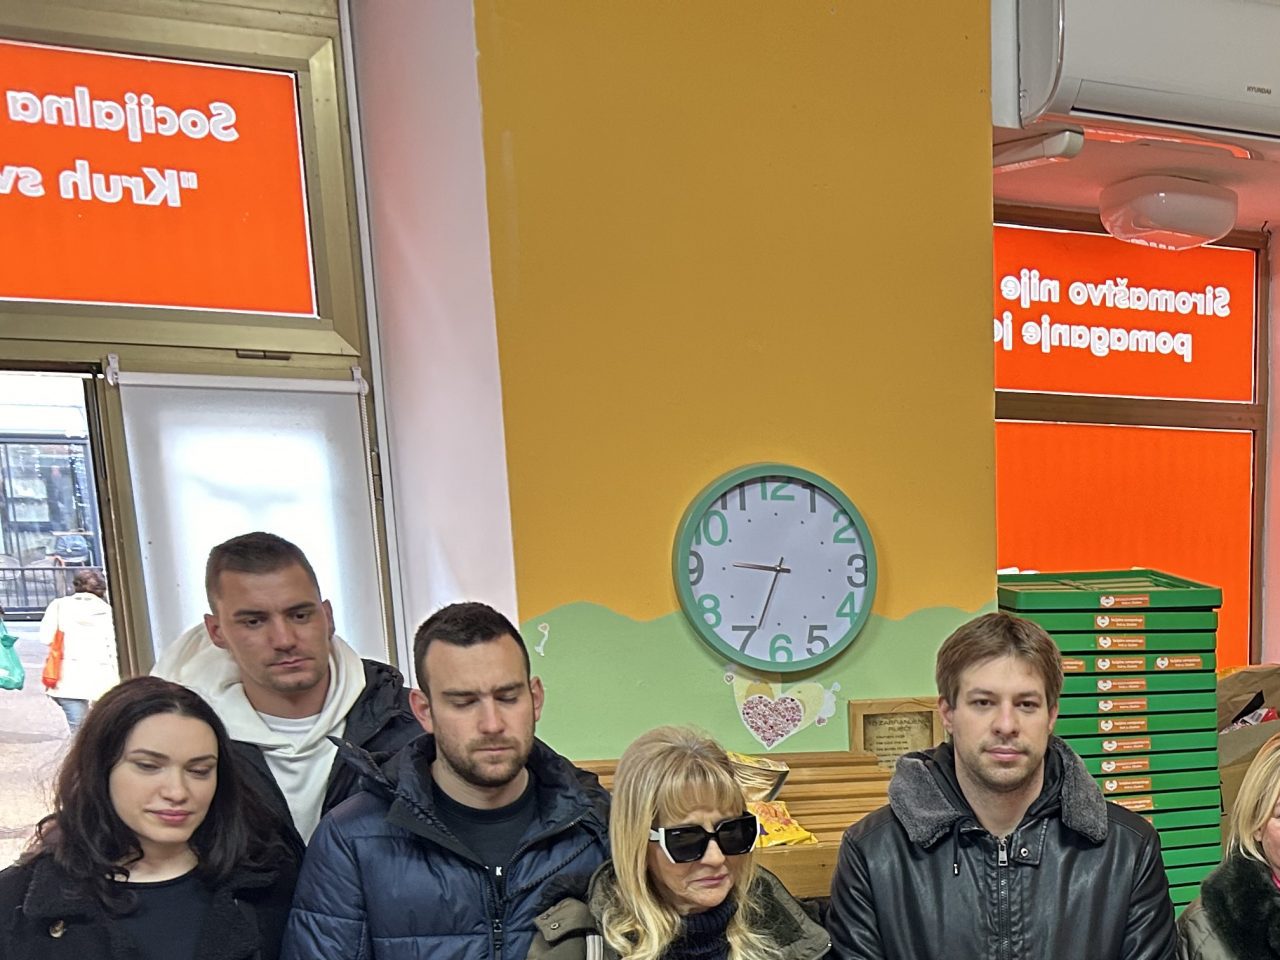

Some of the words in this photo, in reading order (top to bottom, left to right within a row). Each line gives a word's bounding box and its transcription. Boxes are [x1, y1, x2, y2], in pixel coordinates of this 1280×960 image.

[760, 476, 796, 501] 12
[833, 509, 858, 544] 2
[688, 550, 705, 586] 9
[847, 553, 869, 588] 3
[697, 593, 722, 630] 8
[835, 591, 860, 626] 4
[731, 625, 757, 655] 7
[769, 633, 794, 662] 6
[806, 624, 830, 657] 5
